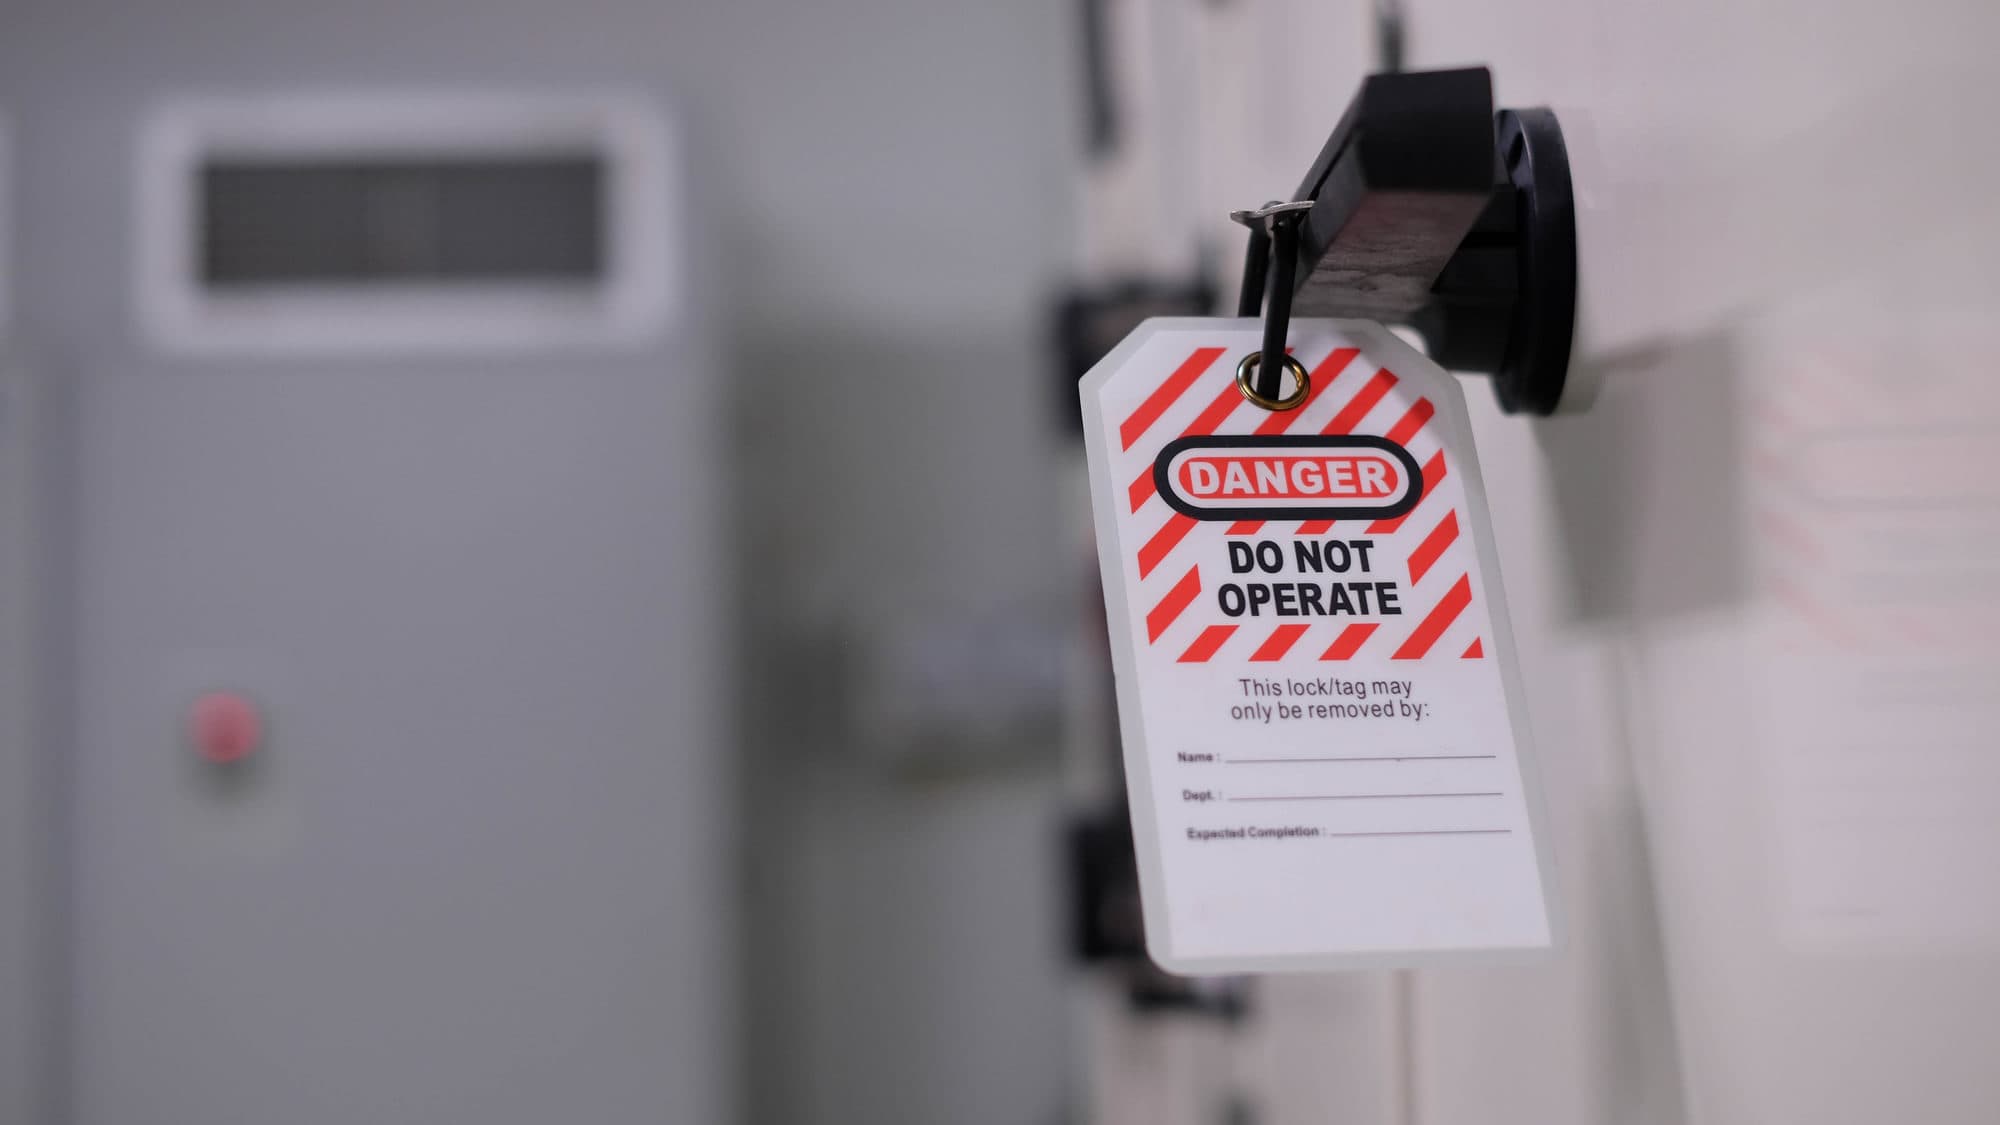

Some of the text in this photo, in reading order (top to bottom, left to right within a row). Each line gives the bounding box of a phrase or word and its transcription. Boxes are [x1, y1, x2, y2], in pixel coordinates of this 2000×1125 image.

[1188, 461, 1391, 495] DANGER
[1228, 540, 1374, 573] DO NOT
[1217, 582, 1402, 617] OPERATE
[1239, 677, 1412, 700] This lock/tag may
[1230, 700, 1431, 724] only be removed by:
